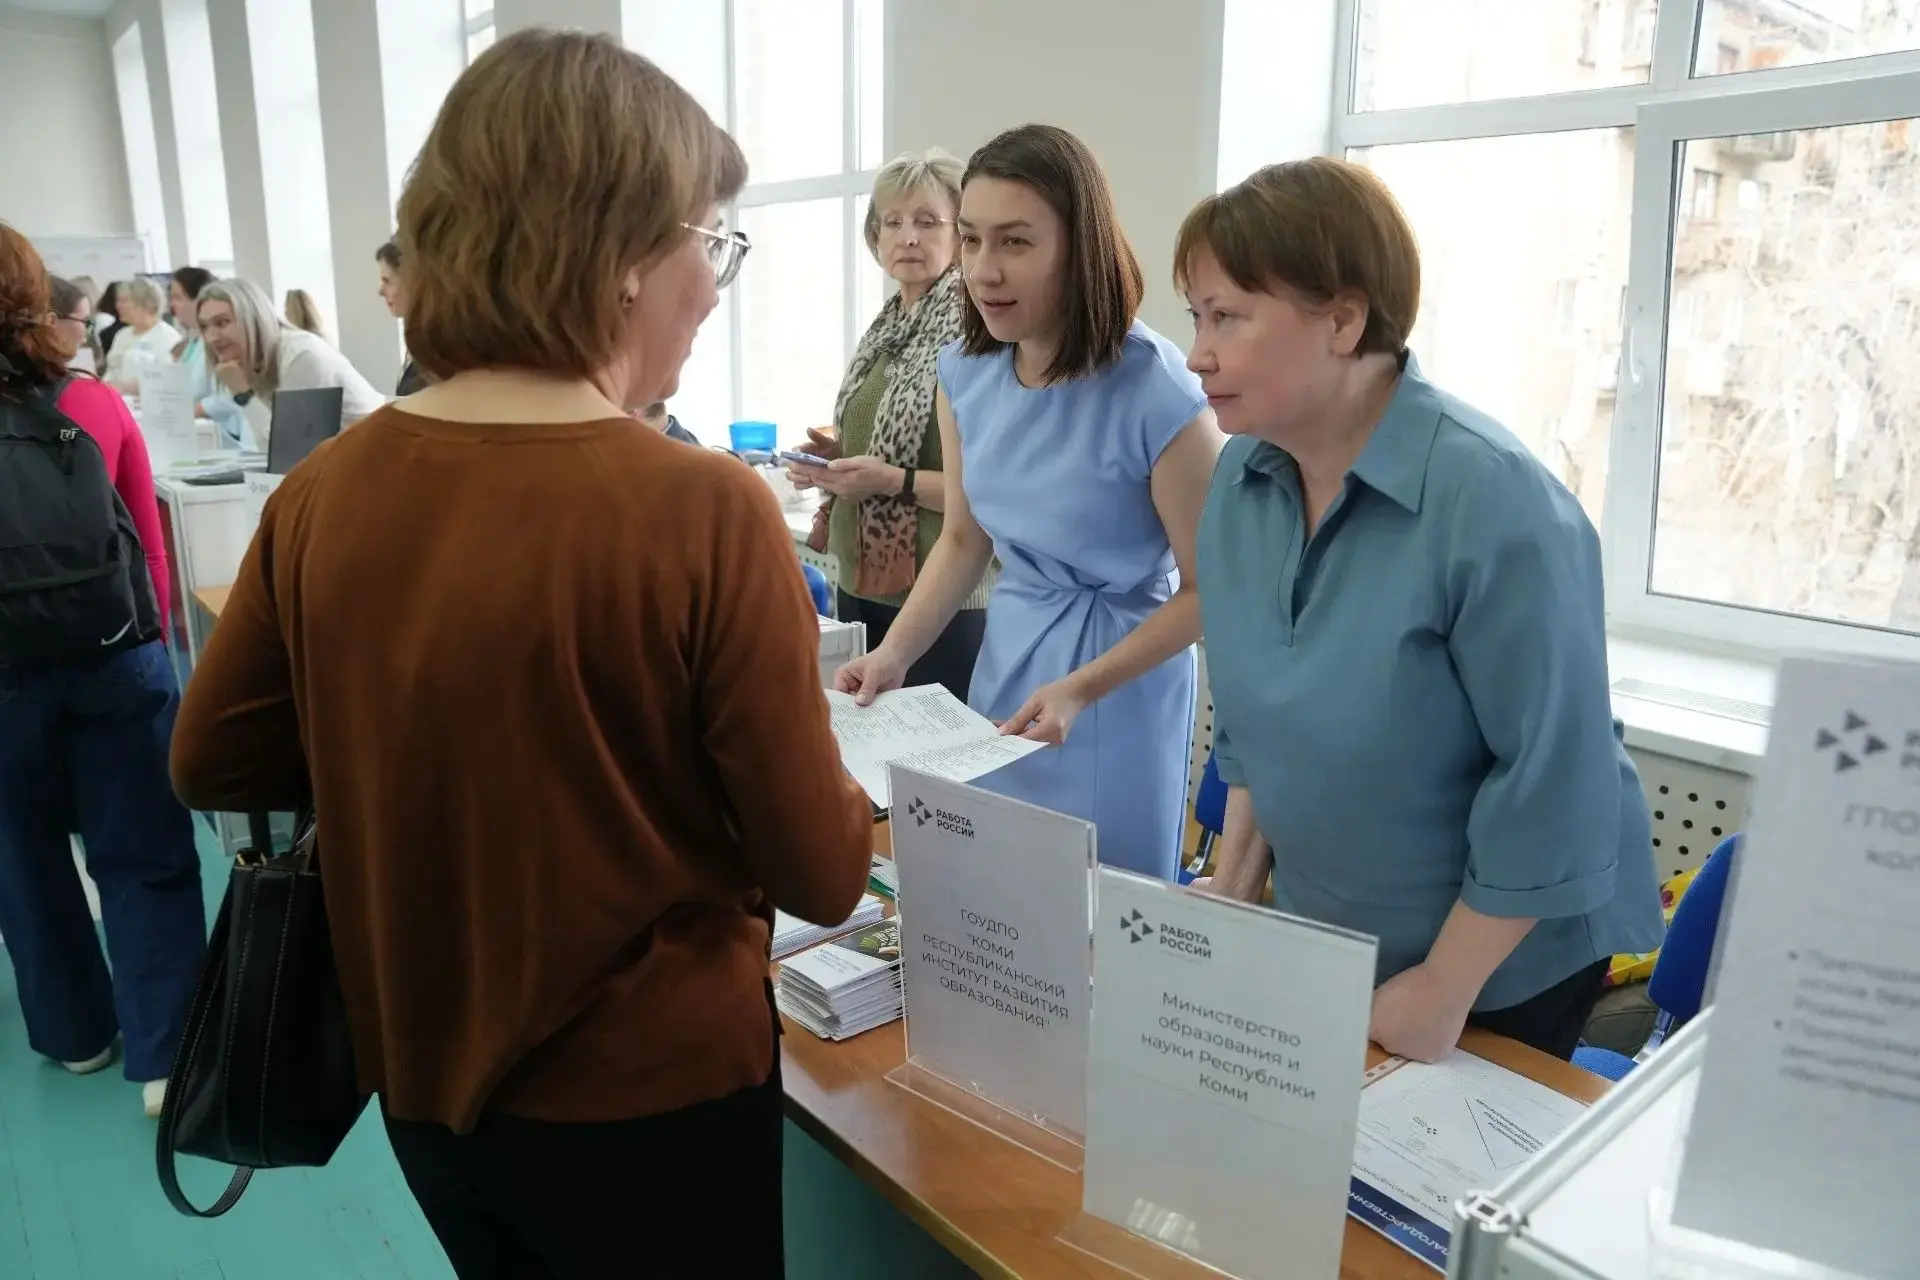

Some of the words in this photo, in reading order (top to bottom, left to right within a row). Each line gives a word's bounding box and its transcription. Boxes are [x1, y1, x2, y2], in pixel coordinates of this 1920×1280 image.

[936, 809, 973, 829] РАБОТА
[936, 819, 975, 840] РОССИИ
[961, 909, 1020, 941] ГОУДПО
[1159, 923, 1210, 946] РАБОТА
[1159, 935, 1212, 960] РОССИИ
[923, 933, 1066, 1000] РЕСПУБЛИКАНСКИЙ
[922, 952, 989, 987] ИНСТИТУТ
[993, 979, 1069, 1020] РАЗВИТИЯ
[1162, 991, 1301, 1048] Министерство
[1158, 1015, 1283, 1067] образования
[1288, 1058, 1301, 1071] и
[1141, 1032, 1195, 1060] науки
[1199, 1049, 1317, 1101] Республики
[1199, 1073, 1249, 1102] Коми
